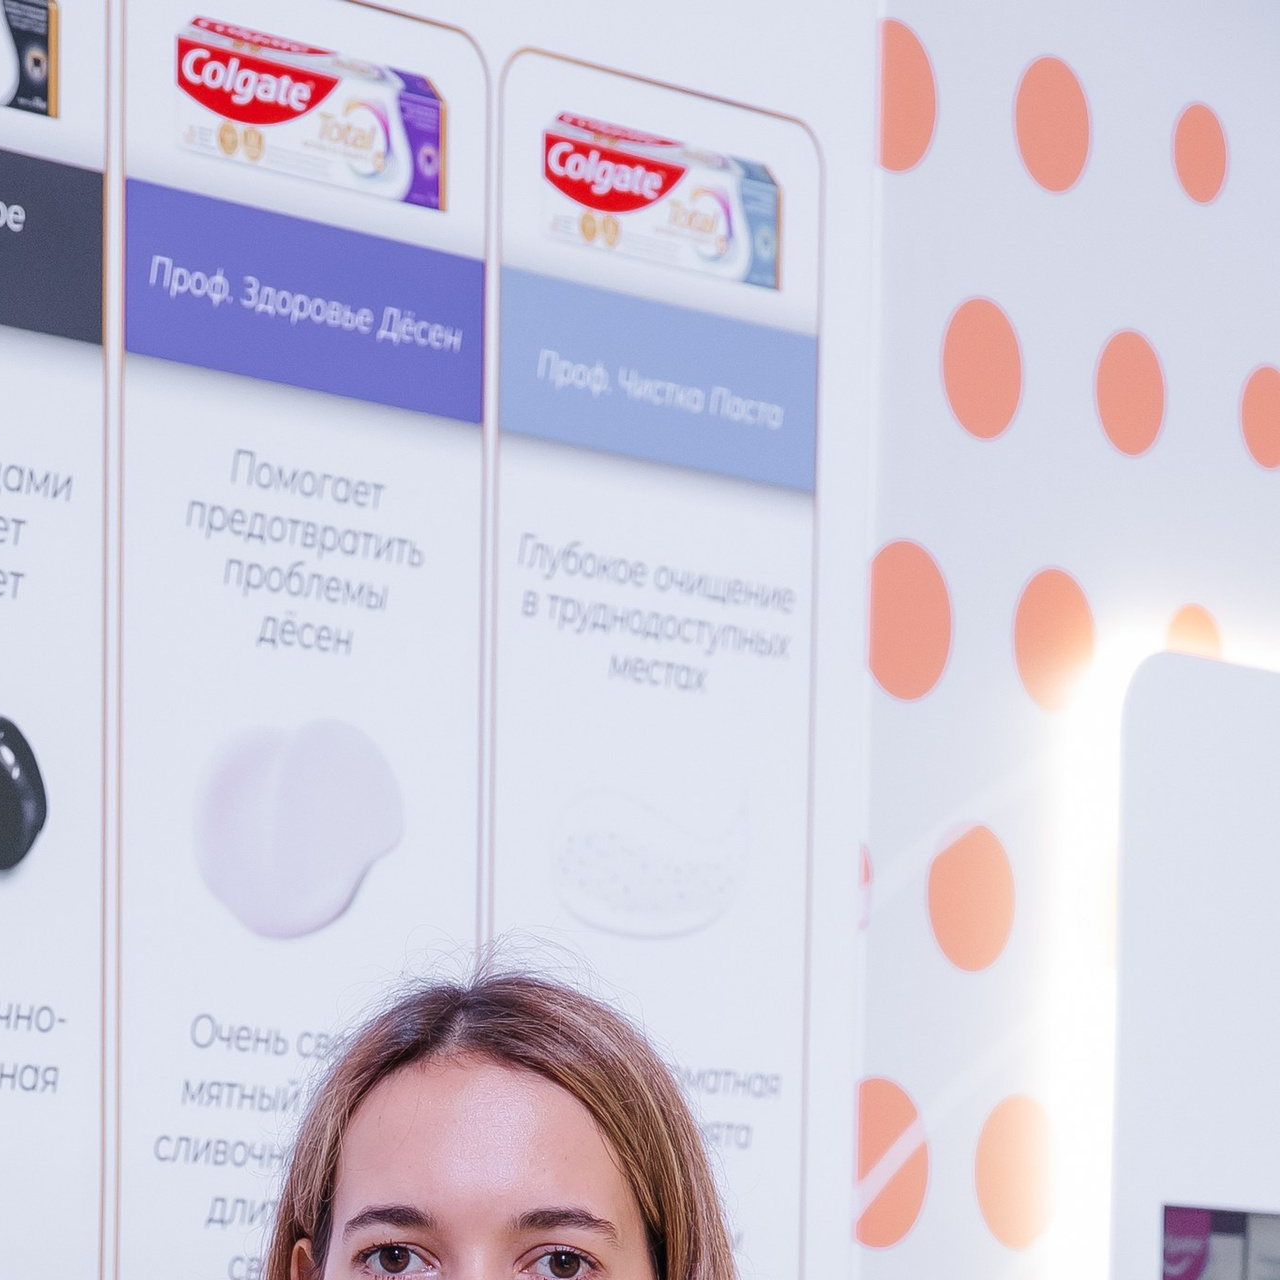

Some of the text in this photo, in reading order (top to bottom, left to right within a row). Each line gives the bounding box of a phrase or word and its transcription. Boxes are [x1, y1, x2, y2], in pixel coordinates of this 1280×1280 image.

[181, 48, 313, 111] Colgate
[547, 141, 664, 200] Colgate
[149, 254, 463, 351] Проф. Здоровье Дёсен
[536, 348, 612, 396] Проф.
[230, 447, 386, 509] Помогает
[185, 499, 424, 568] предотвратить
[223, 557, 389, 611] проблемы
[517, 531, 796, 615] Глубокое очищение
[255, 611, 353, 655] дёсен
[546, 593, 791, 658] труднодоступных
[608, 654, 708, 692] местах
[190, 1012, 289, 1057] Очень
[181, 1079, 300, 1113] мятный
